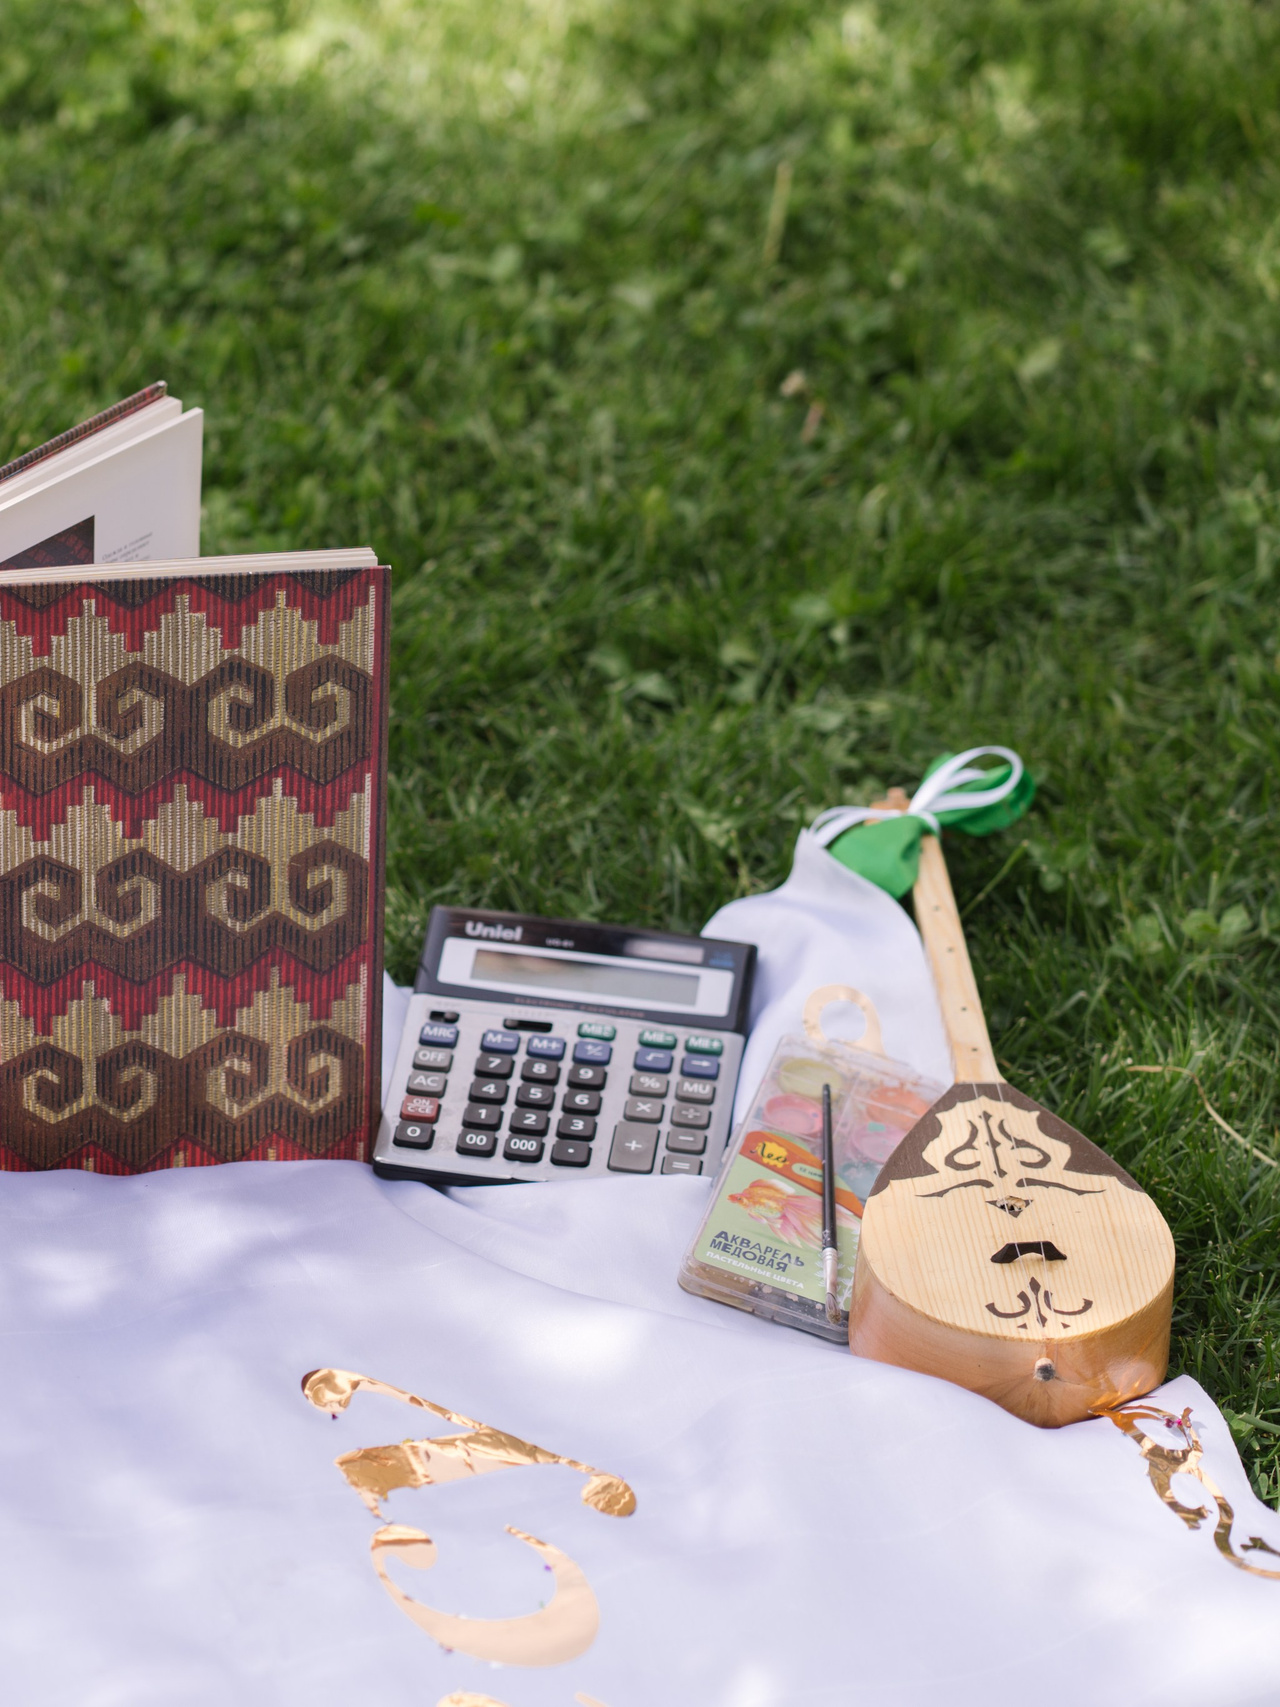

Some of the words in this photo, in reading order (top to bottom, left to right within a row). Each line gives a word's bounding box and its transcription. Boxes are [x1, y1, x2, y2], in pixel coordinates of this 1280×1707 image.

[465, 921, 523, 941] Uniel
[423, 1026, 455, 1038] MRC
[532, 1038, 560, 1050] M+
[418, 1050, 446, 1062] OFF
[488, 1057, 501, 1068] 7
[532, 1063, 547, 1074] 8
[579, 1068, 593, 1079] 9
[413, 1075, 439, 1087] AC
[482, 1084, 496, 1094] 4
[529, 1088, 543, 1099] 5
[683, 1082, 710, 1094] MU
[413, 1098, 430, 1106] ON
[575, 1094, 589, 1105] 6
[478, 1109, 487, 1119] 1
[523, 1114, 537, 1124] 2
[570, 1119, 584, 1130] 3
[407, 1126, 421, 1137] 0
[465, 1134, 487, 1146] 00
[510, 1138, 537, 1151] 000
[750, 1141, 787, 1163] Лео
[714, 1231, 805, 1267] АКВАРЕЛЬ
[709, 1238, 788, 1273] МЕДОВАЯ
[705, 1250, 772, 1278] ПАСТЕЛЬНЫЕ
[773, 1273, 805, 1290] ЦВЕТА
